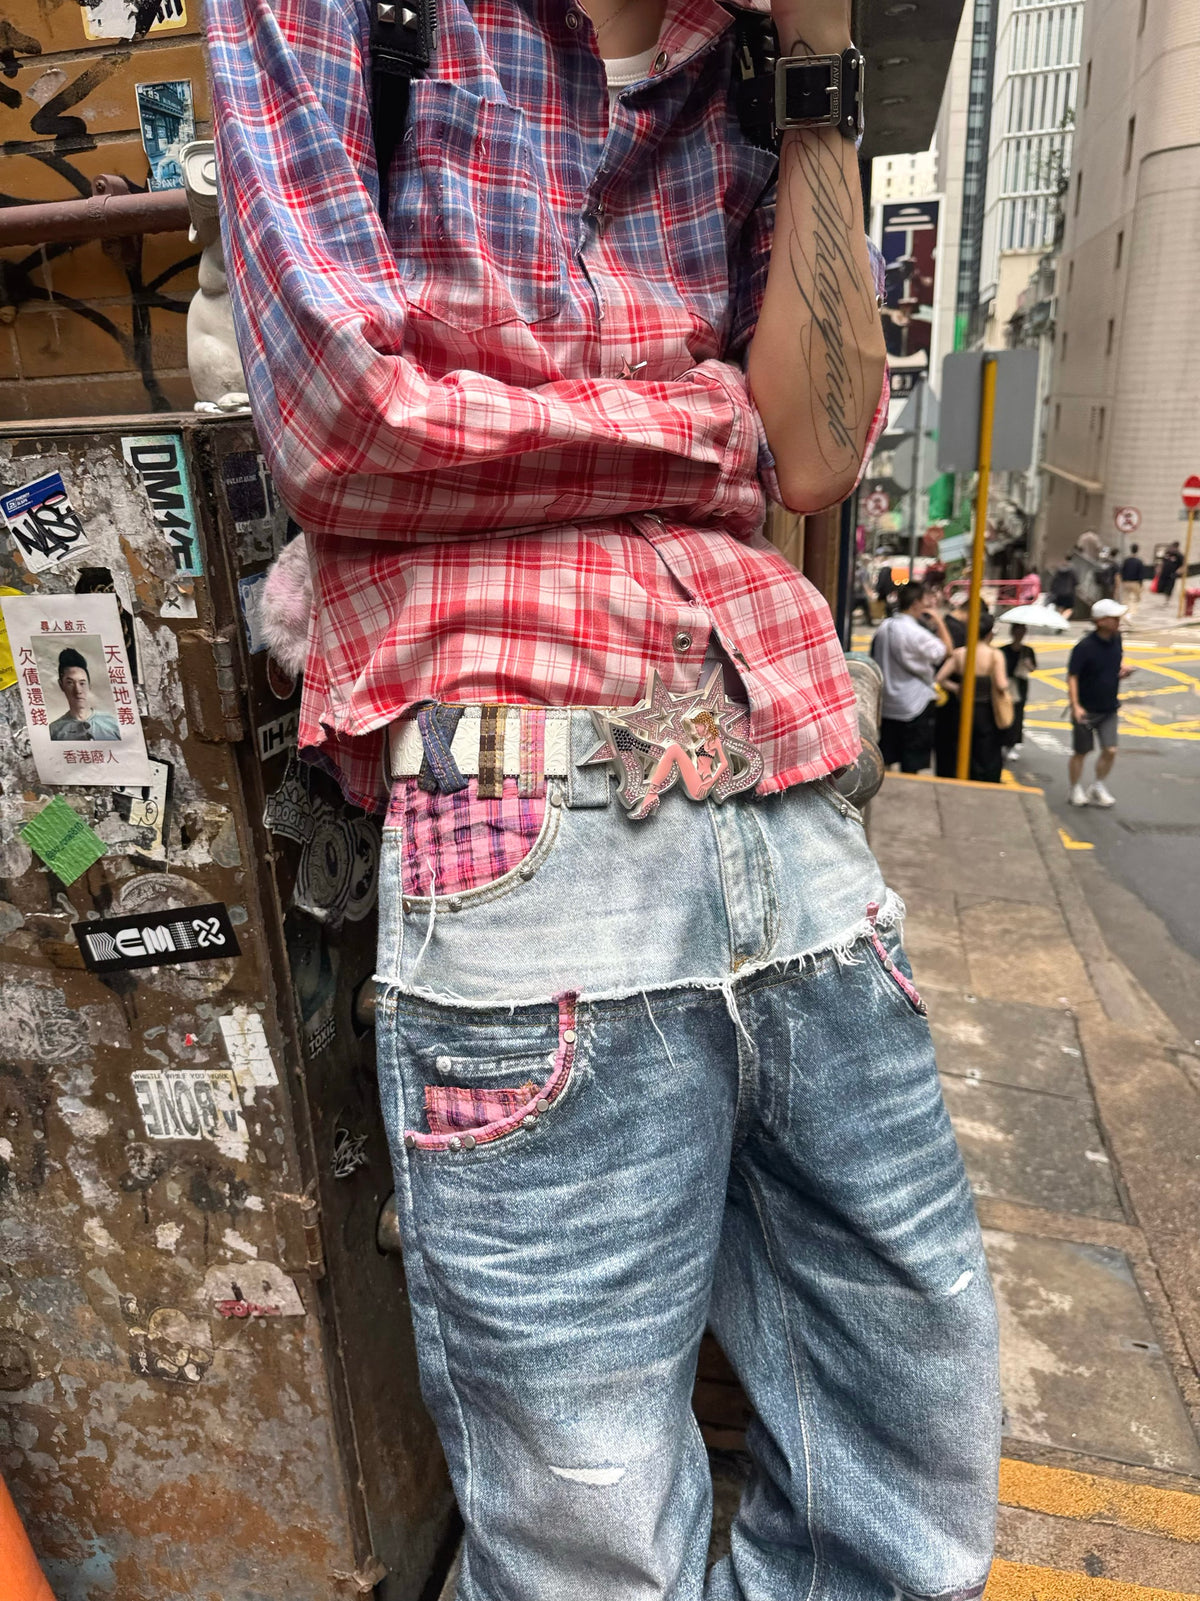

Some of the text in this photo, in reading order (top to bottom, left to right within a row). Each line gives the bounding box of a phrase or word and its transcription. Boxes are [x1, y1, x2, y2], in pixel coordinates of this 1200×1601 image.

[19, 647, 49, 726] 欠債還錢
[104, 645, 135, 725] 天經地義
[63, 750, 120, 764] 香港廢人
[85, 916, 226, 962] REMIX
[308, 1021, 336, 1053] TOXIC
